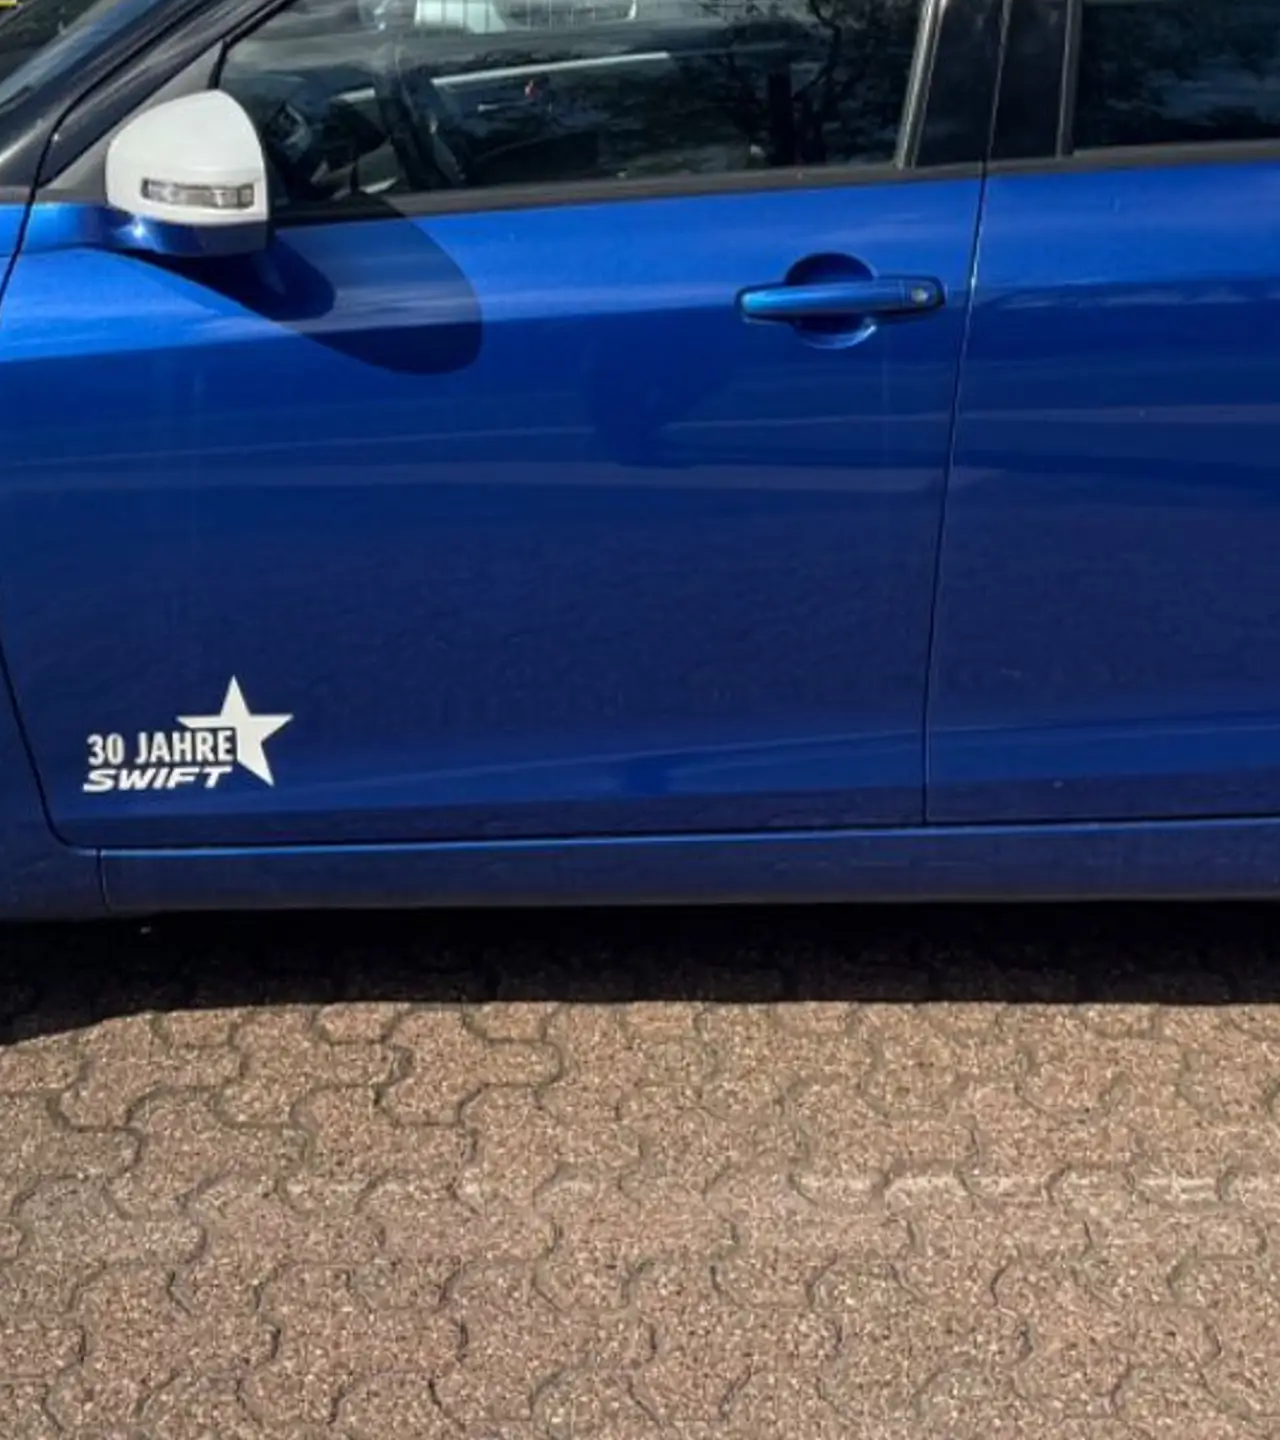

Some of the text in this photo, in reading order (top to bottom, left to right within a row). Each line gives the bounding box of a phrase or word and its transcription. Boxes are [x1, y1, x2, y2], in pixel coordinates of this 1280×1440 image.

[86, 729, 234, 766] 30 JAHRE
[82, 765, 233, 793] SWIFT
